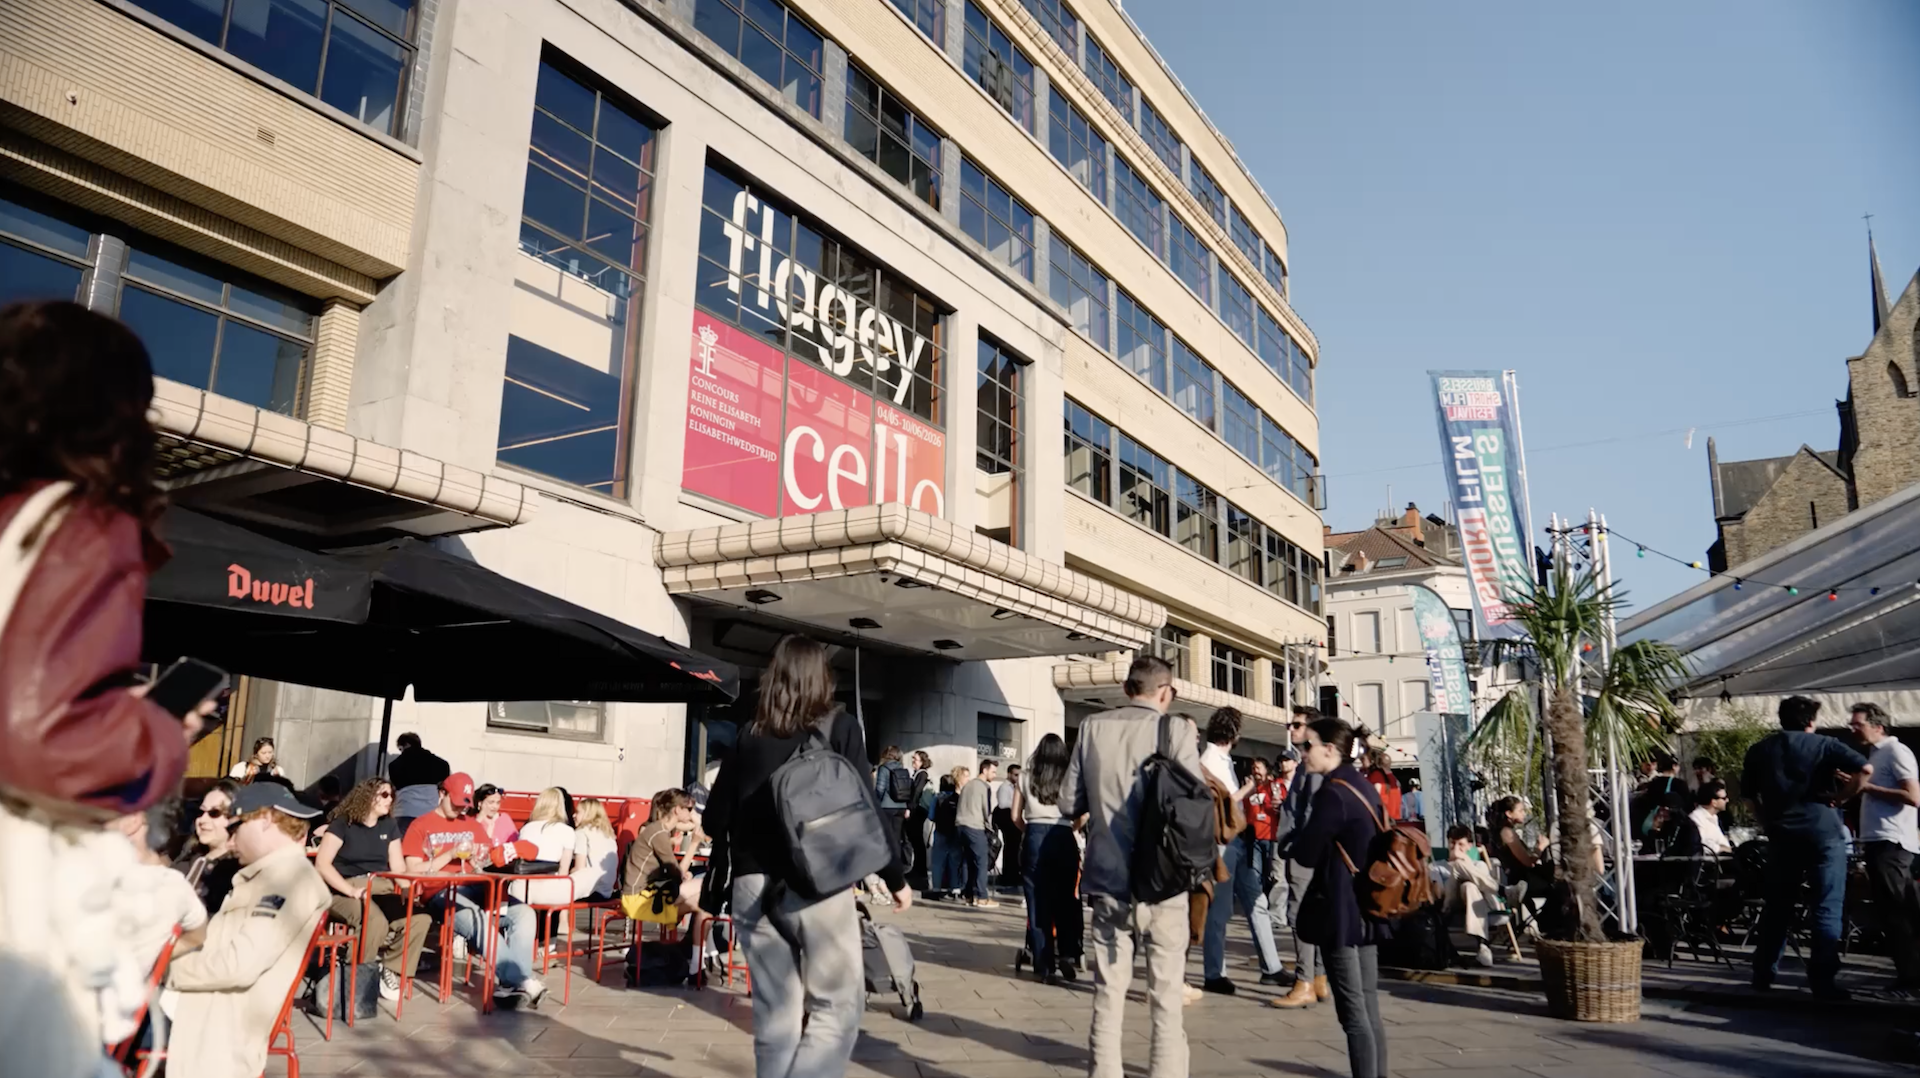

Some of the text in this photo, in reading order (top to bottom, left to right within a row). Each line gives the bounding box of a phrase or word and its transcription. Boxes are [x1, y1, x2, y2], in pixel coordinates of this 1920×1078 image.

[724, 191, 924, 405] flagey
[691, 375, 739, 403] CONCOURS
[691, 390, 761, 427] REINE ELISABETH
[690, 404, 735, 431] KONINGIN
[689, 419, 777, 462] ELISABETHWEDSTRIJD
[227, 564, 314, 609] Duvel
